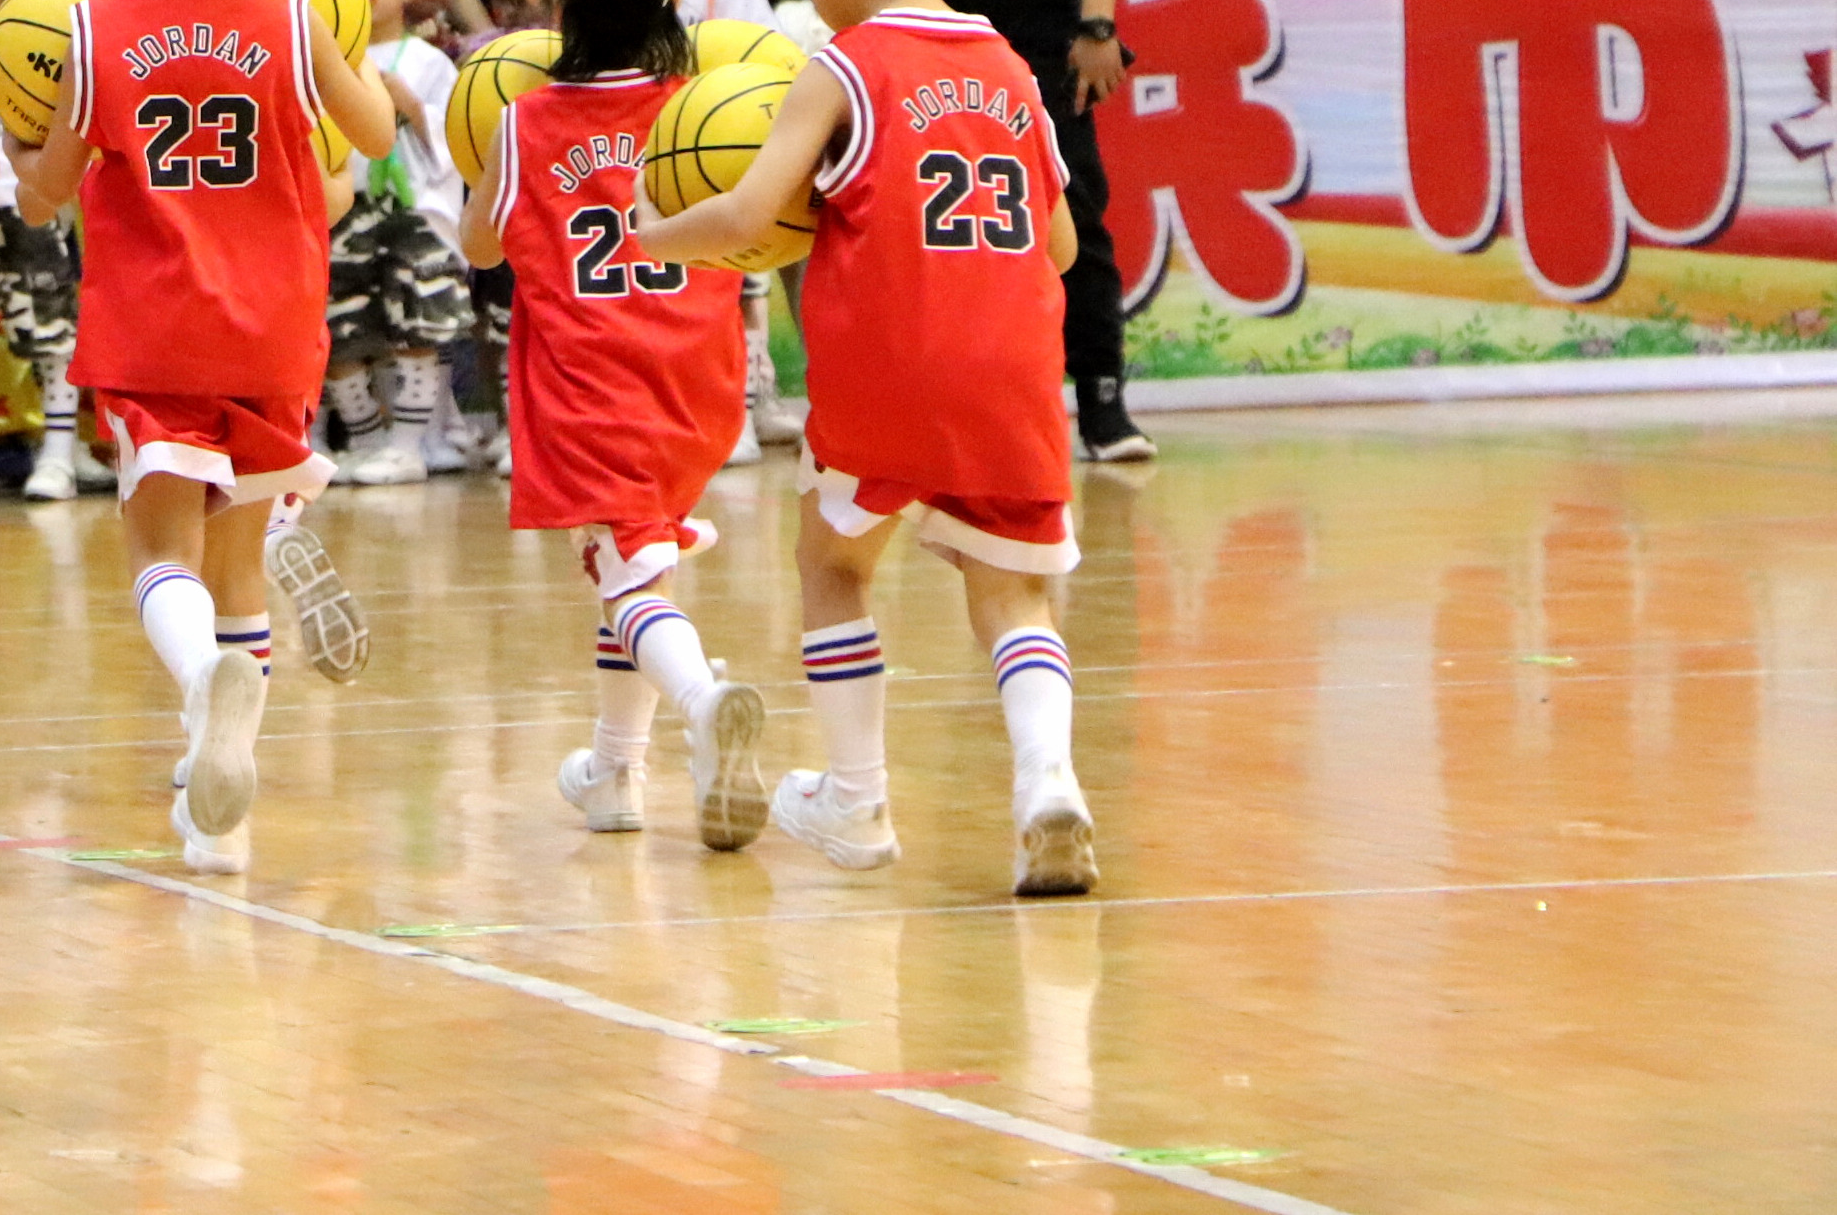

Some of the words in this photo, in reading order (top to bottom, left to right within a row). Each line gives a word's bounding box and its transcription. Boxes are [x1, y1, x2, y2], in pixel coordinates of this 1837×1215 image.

[122, 23, 271, 79] JORDAN
[902, 78, 1034, 140] JORDAN
[135, 94, 260, 190] 23
[550, 132, 646, 194] JORD
[917, 150, 1035, 254] 23
